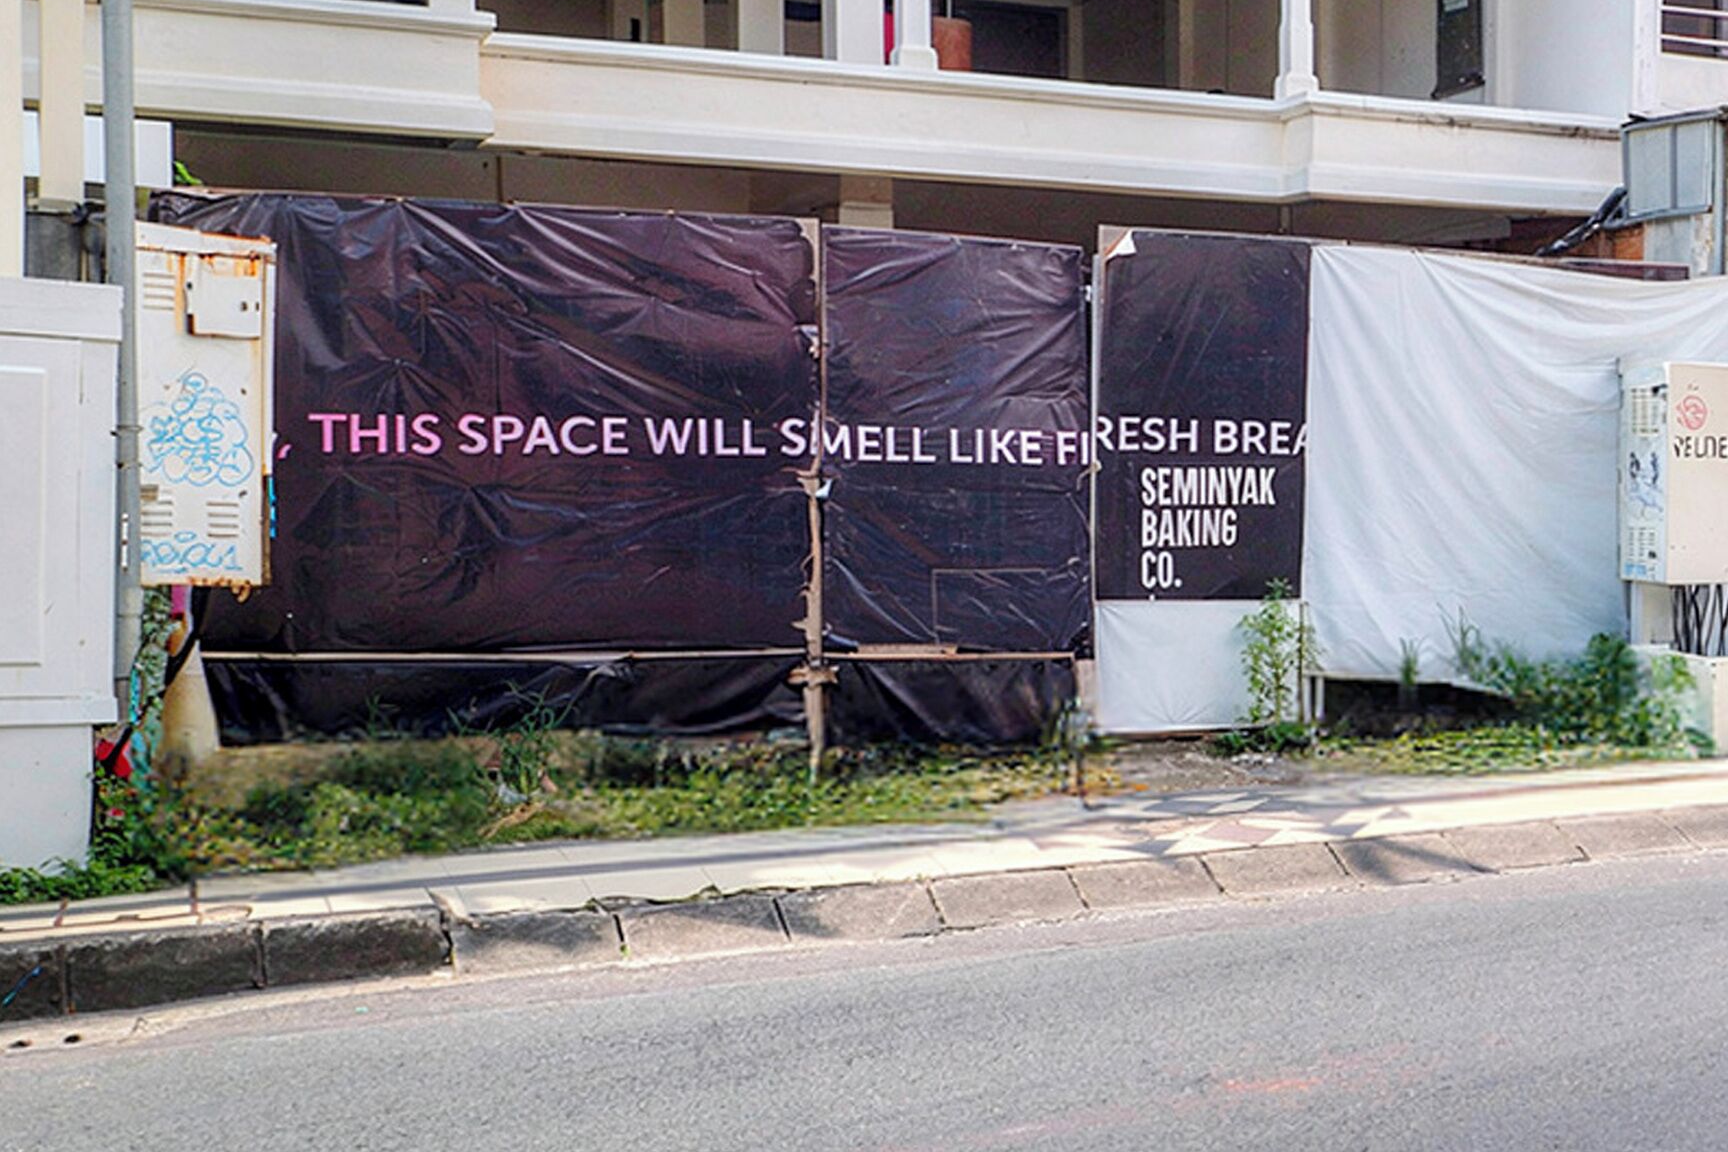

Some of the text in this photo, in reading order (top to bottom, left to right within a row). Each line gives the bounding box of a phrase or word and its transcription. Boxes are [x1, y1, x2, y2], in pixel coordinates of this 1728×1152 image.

[308, 413, 443, 455] THIS
[457, 414, 631, 455] SPACE
[644, 417, 767, 456] WILL
[780, 417, 937, 463] SMELL
[950, 428, 1043, 465] LIKE
[1140, 466, 1277, 506] SEMINYAK
[1140, 508, 1238, 548] BAKING
[1140, 551, 1182, 588] CO.
